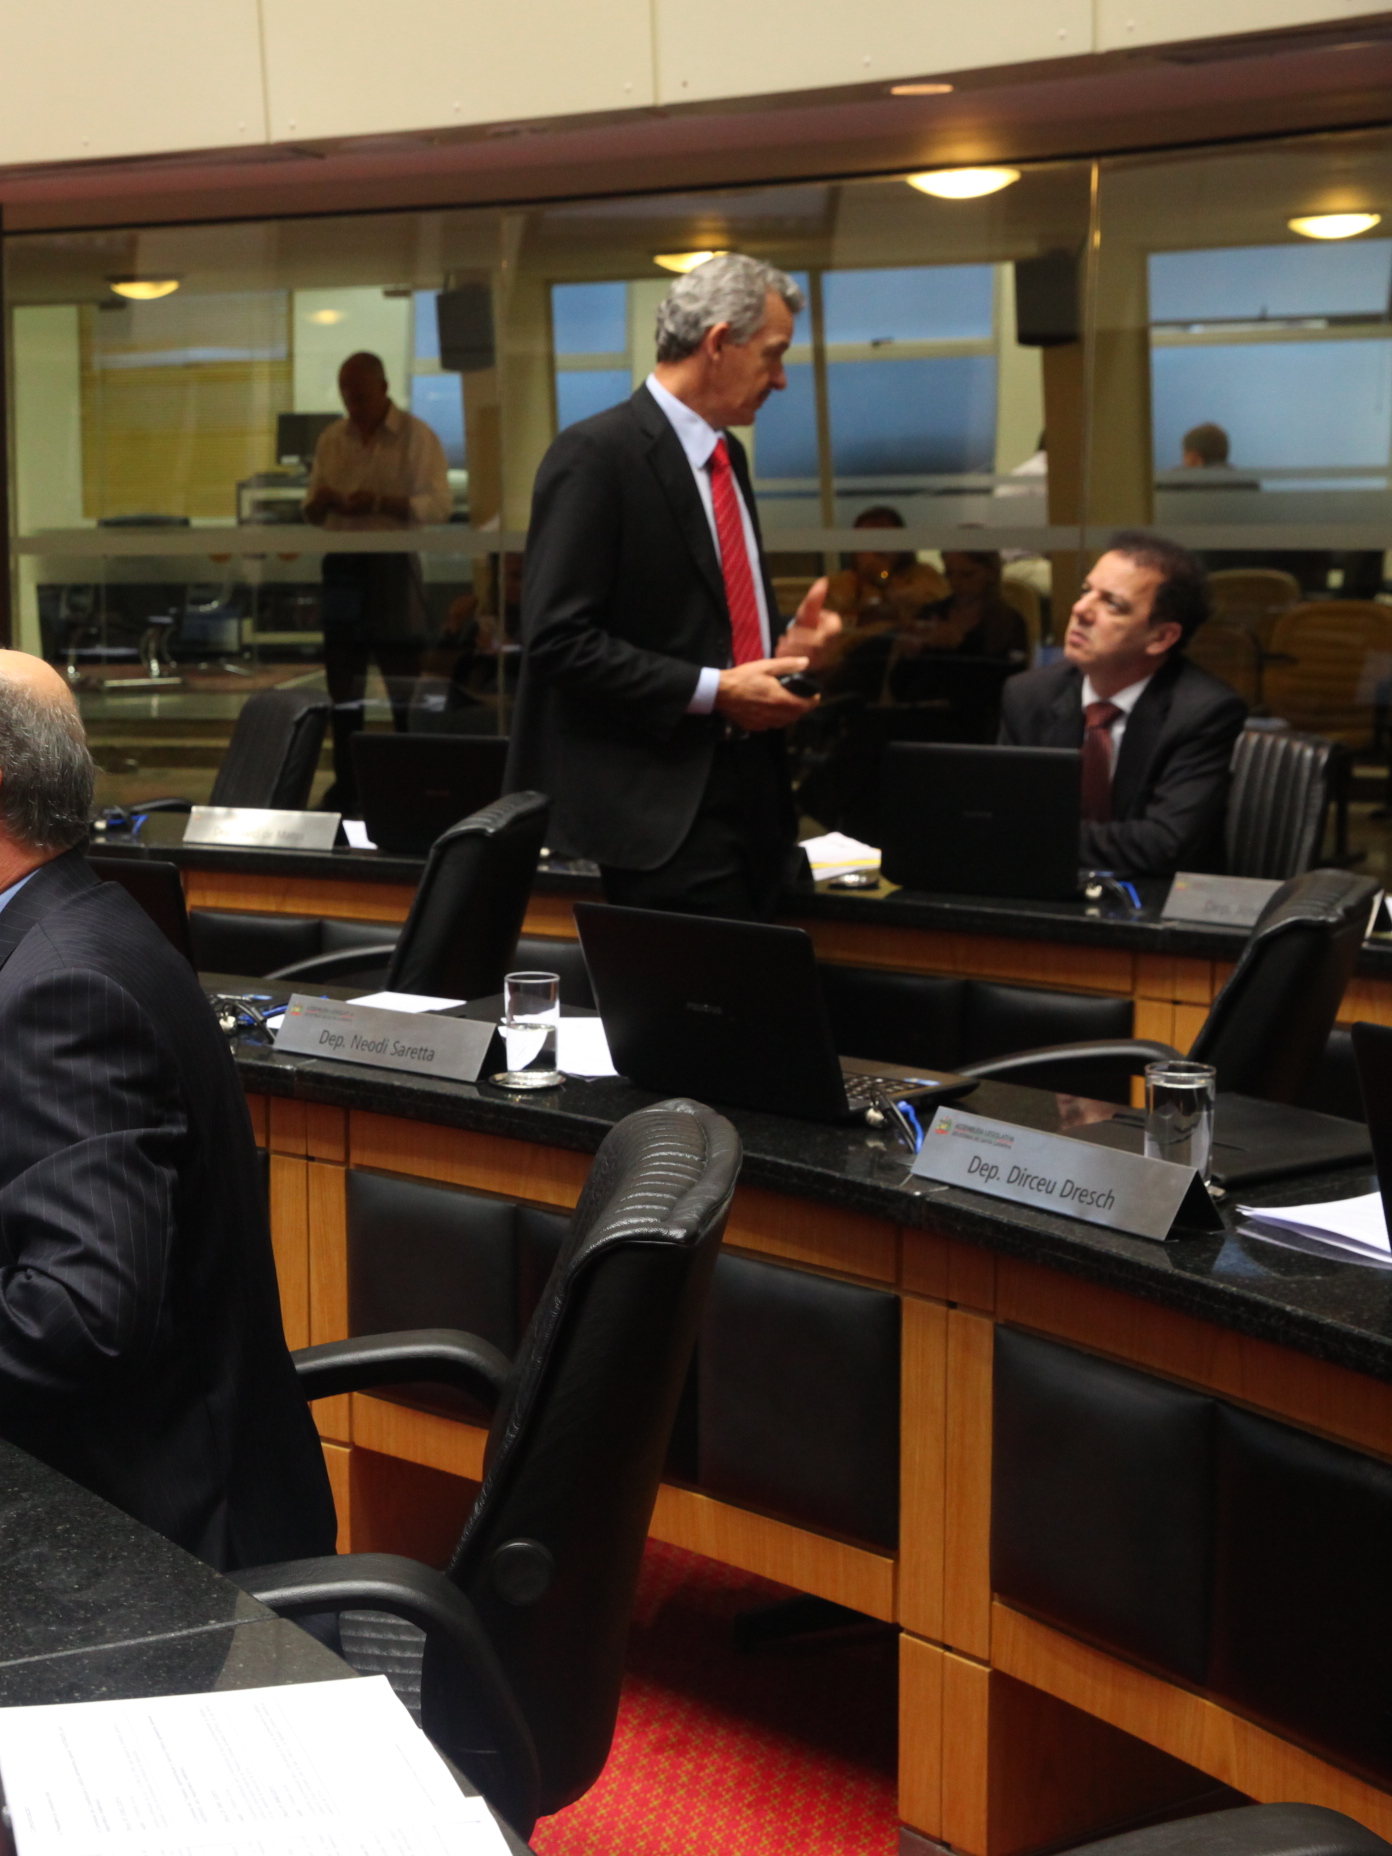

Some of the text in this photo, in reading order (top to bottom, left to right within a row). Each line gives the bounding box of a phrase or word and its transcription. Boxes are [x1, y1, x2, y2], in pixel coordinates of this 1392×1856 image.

[319, 1029, 435, 1062] Dep. Neodi Saretta
[967, 1155, 1115, 1210] Dep. Dirceu Dresch
